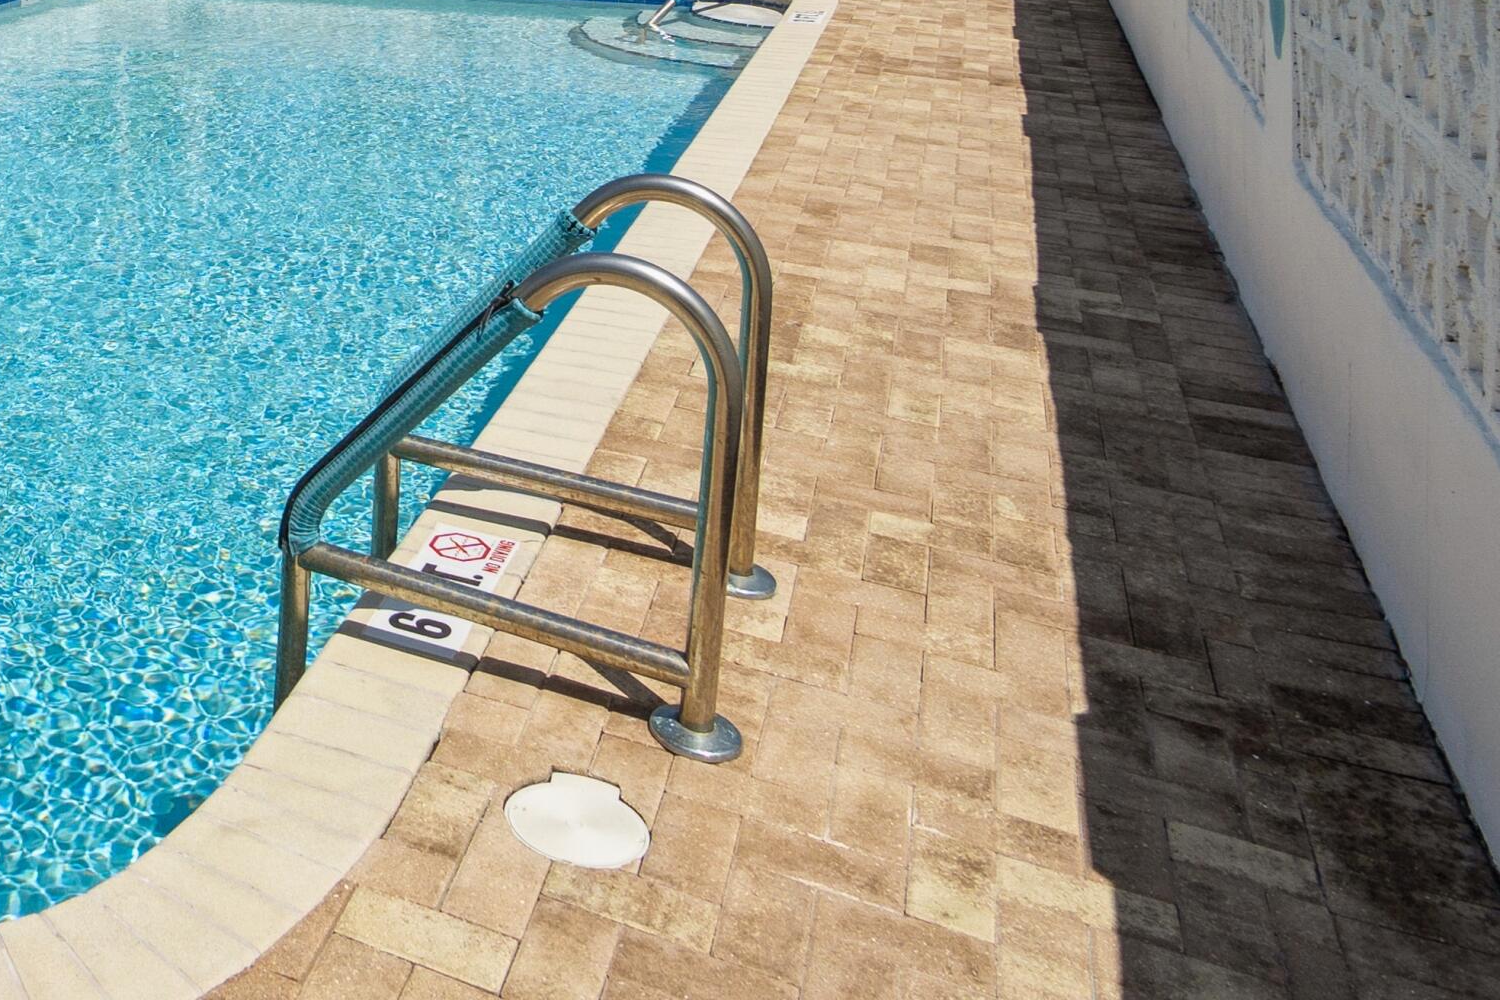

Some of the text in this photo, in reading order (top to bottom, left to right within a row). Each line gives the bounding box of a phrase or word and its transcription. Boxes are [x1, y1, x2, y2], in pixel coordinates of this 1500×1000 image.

[481, 540, 516, 574] NO DIVING
[388, 612, 452, 639] 6
